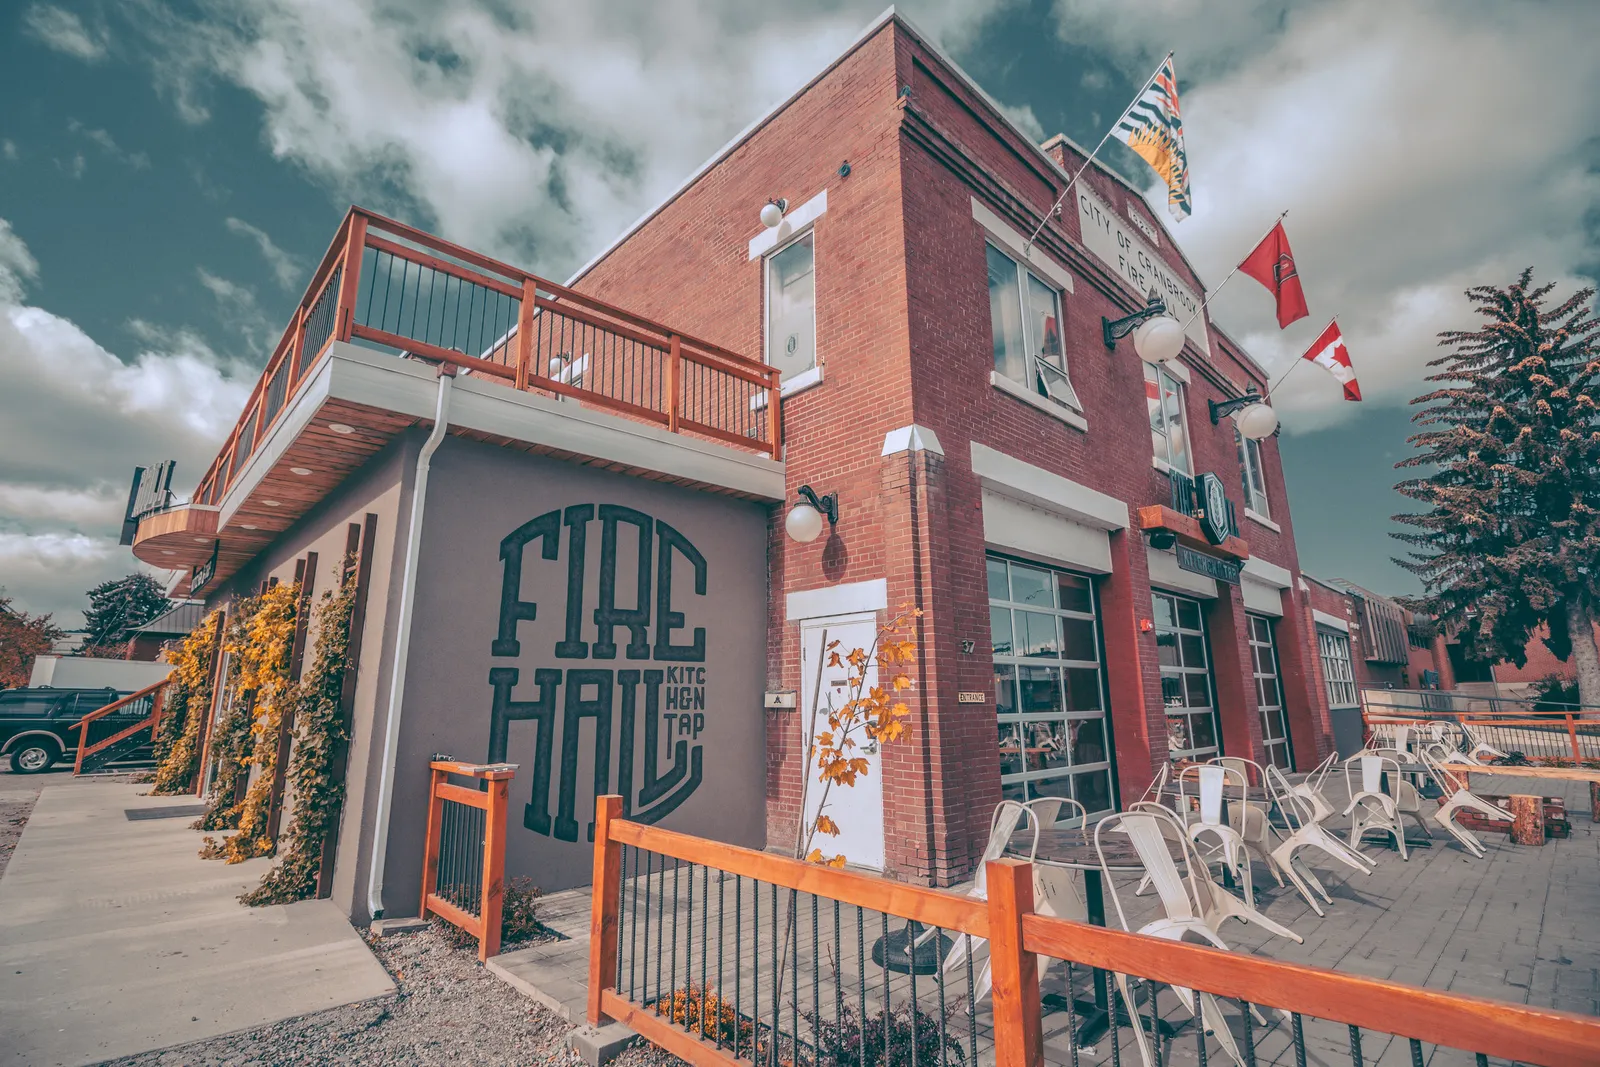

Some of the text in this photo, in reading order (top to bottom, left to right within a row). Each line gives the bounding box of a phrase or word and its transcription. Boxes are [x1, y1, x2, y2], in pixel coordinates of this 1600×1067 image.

[1081, 195, 1198, 319] CITY OF CRANBROOK
[1118, 255, 1147, 293] FIRE
[491, 503, 708, 662] FIRE
[962, 640, 975, 654] 37
[667, 666, 706, 684] KITC
[960, 693, 984, 702] ENTRANCE
[480, 667, 704, 843] HALL
[664, 713, 705, 760] TAP
